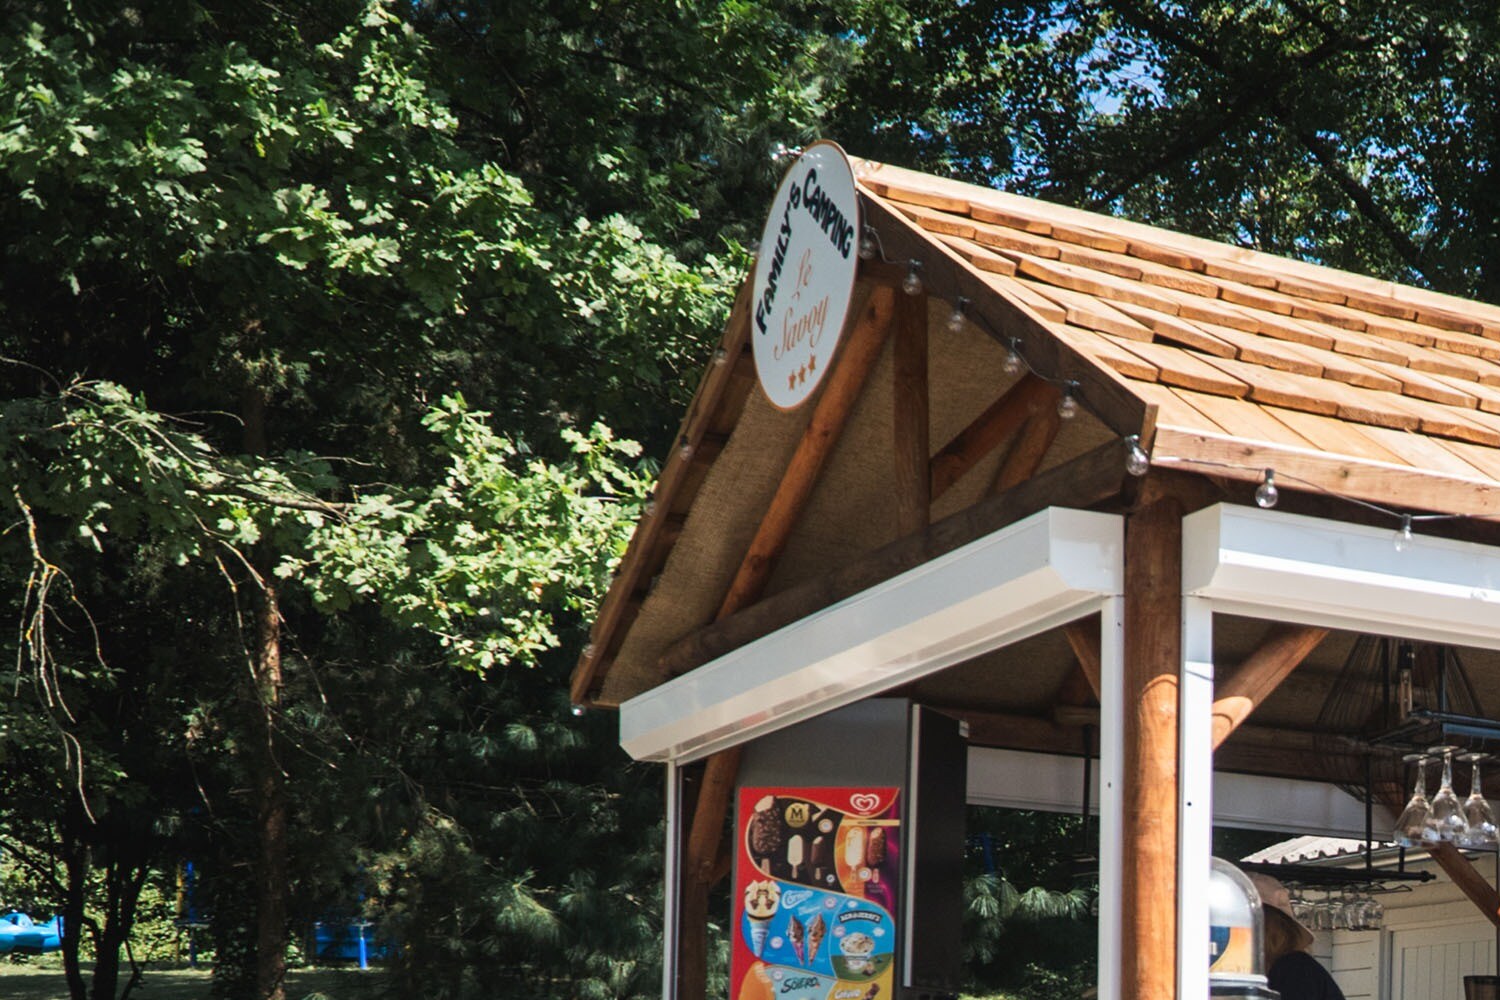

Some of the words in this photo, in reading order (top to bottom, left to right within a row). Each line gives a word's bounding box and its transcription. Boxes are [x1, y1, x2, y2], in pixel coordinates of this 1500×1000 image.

[755, 181, 801, 335] FAMILY'S
[803, 168, 854, 260] CAMPING
[773, 294, 830, 361] Savoy
